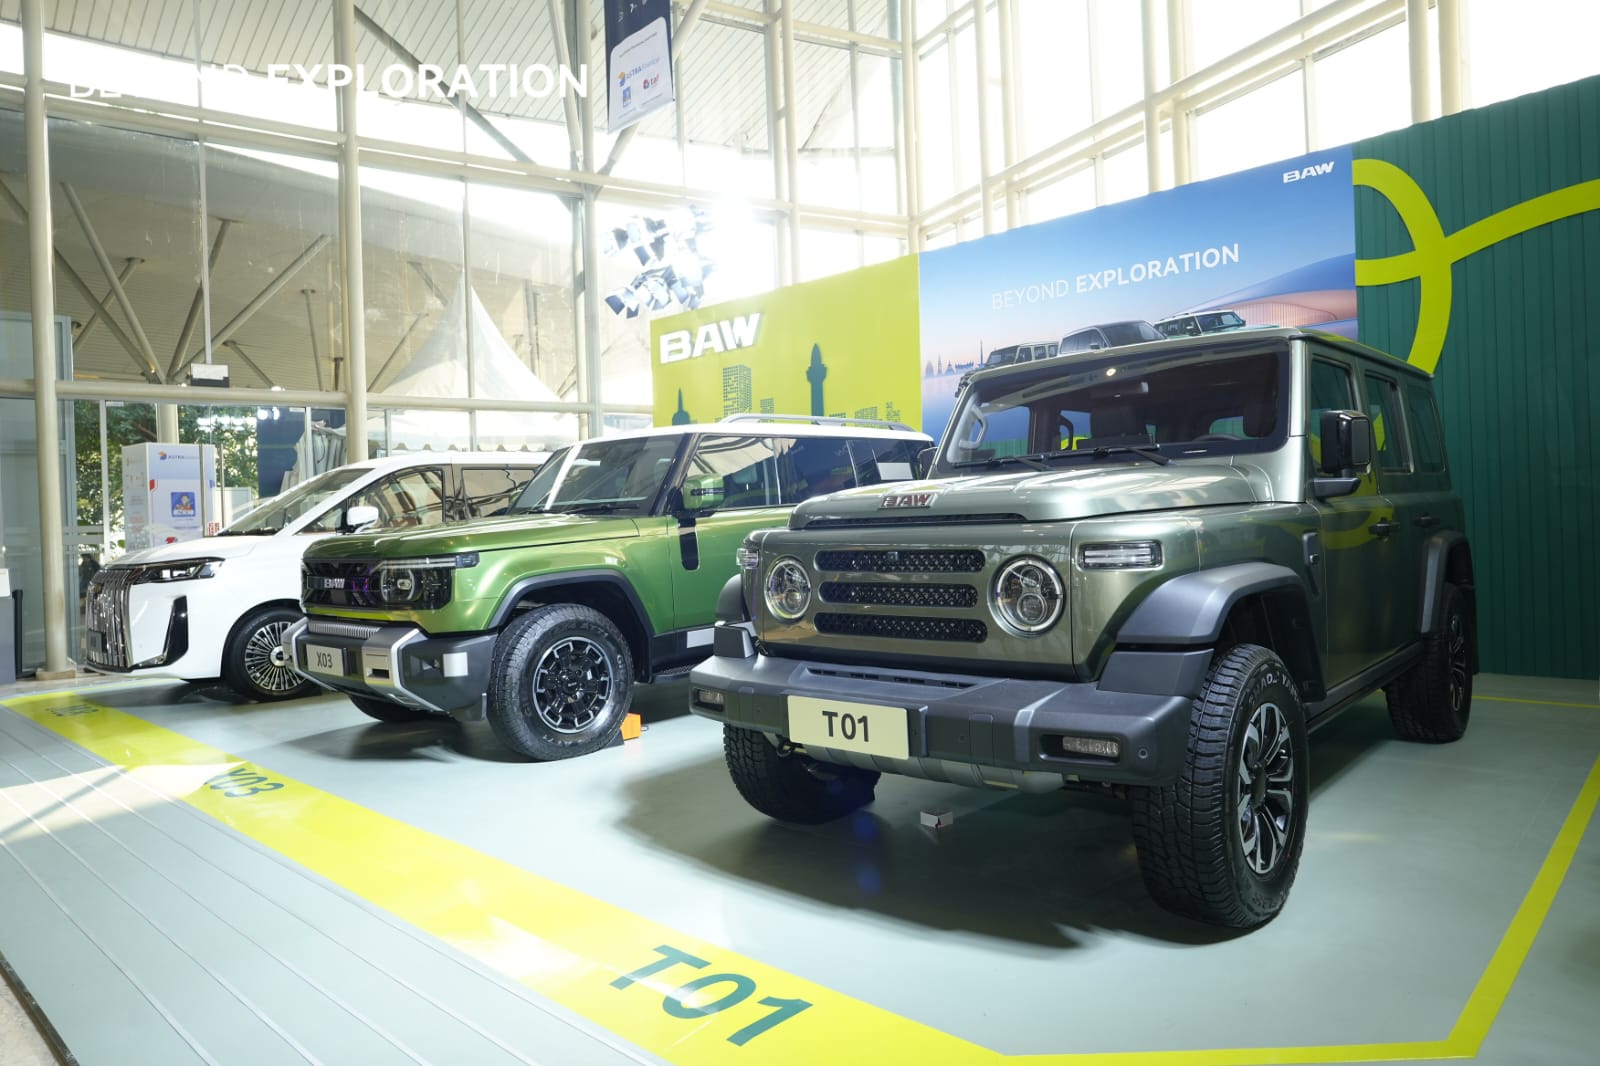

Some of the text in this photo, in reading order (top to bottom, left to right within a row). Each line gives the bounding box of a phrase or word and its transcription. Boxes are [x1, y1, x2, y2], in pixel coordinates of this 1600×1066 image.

[1282, 160, 1335, 184] BAW
[991, 243, 1240, 311] BEYOND EXPLORATION
[659, 312, 761, 365] BAW
[880, 492, 935, 509] BAW
[323, 578, 346, 589] BAW
[316, 652, 333, 669] X03
[821, 710, 869, 743] T01
[608, 944, 814, 1047] T01
